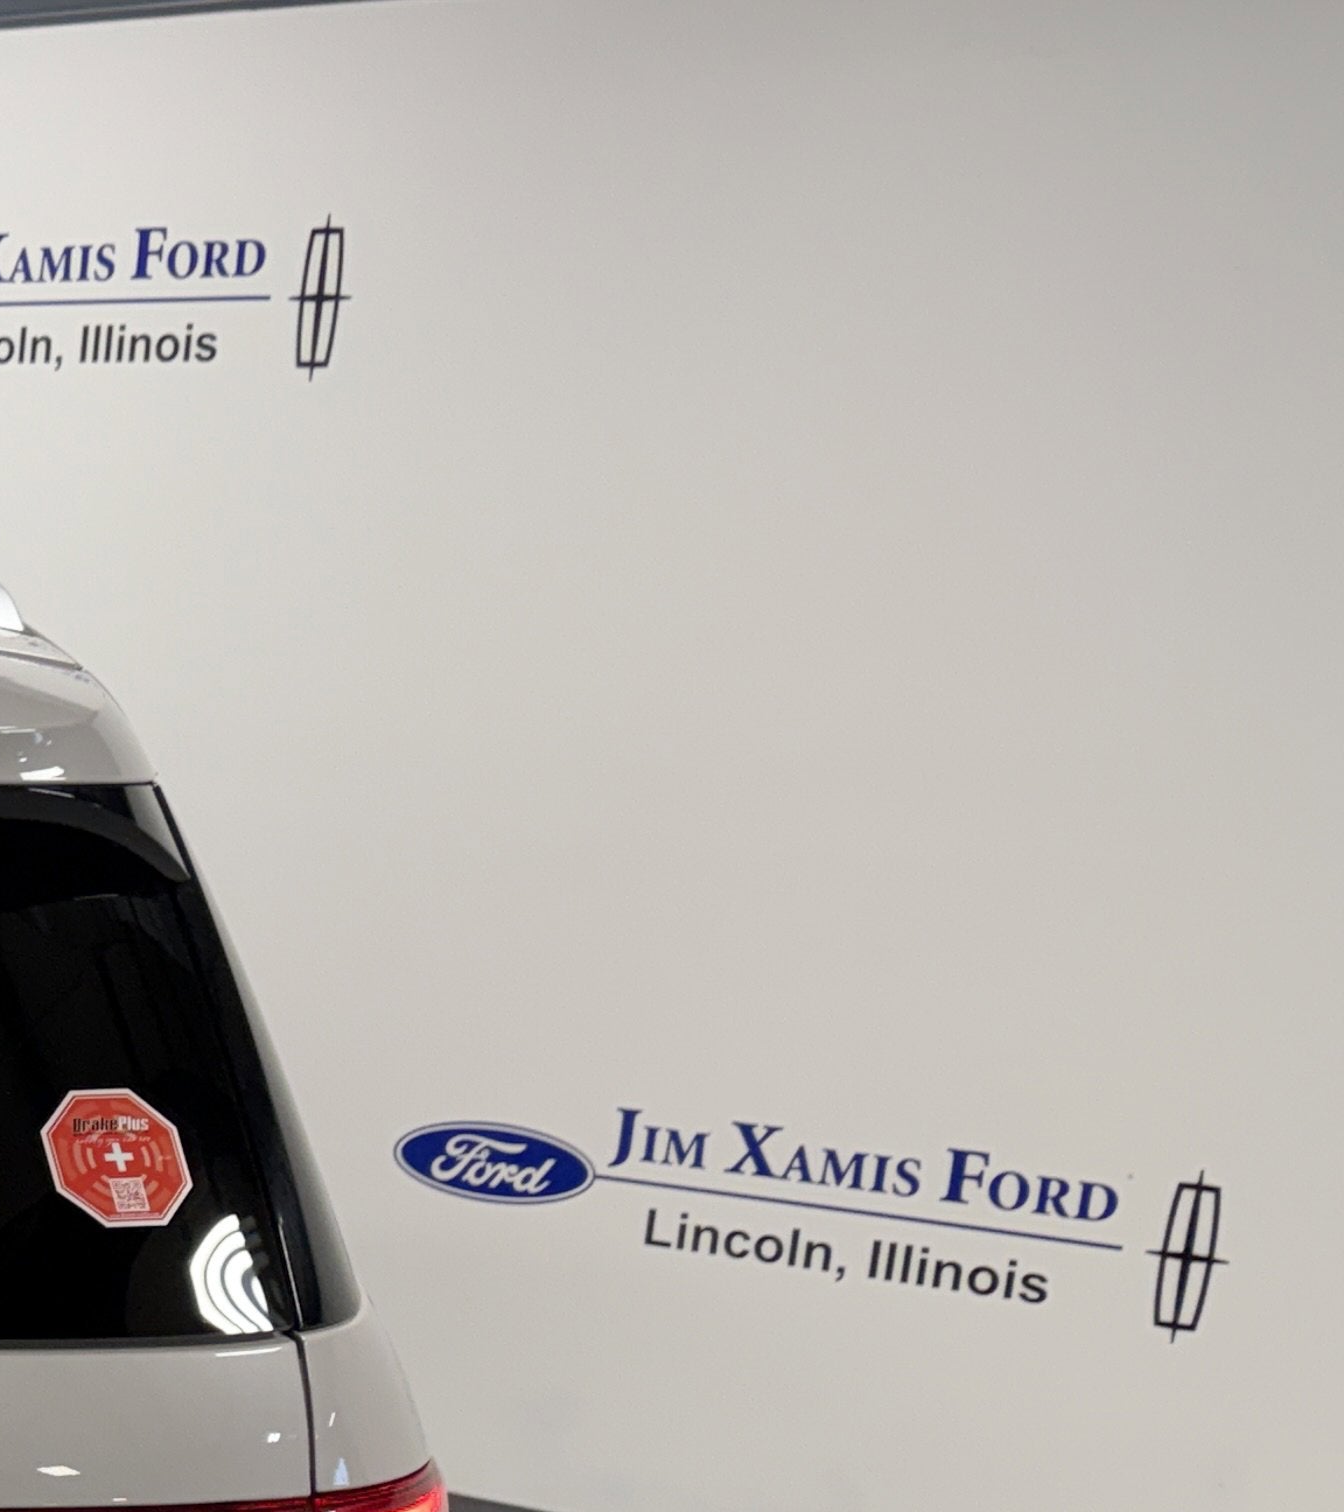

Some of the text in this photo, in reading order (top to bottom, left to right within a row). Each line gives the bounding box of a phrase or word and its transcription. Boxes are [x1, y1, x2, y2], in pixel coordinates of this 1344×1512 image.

[131, 227, 266, 280] FORD
[79, 323, 217, 363] Illinois
[431, 1134, 554, 1196] Ford
[940, 1148, 1119, 1221] FORD
[644, 1208, 1048, 1304] Lincoln, Illinois
